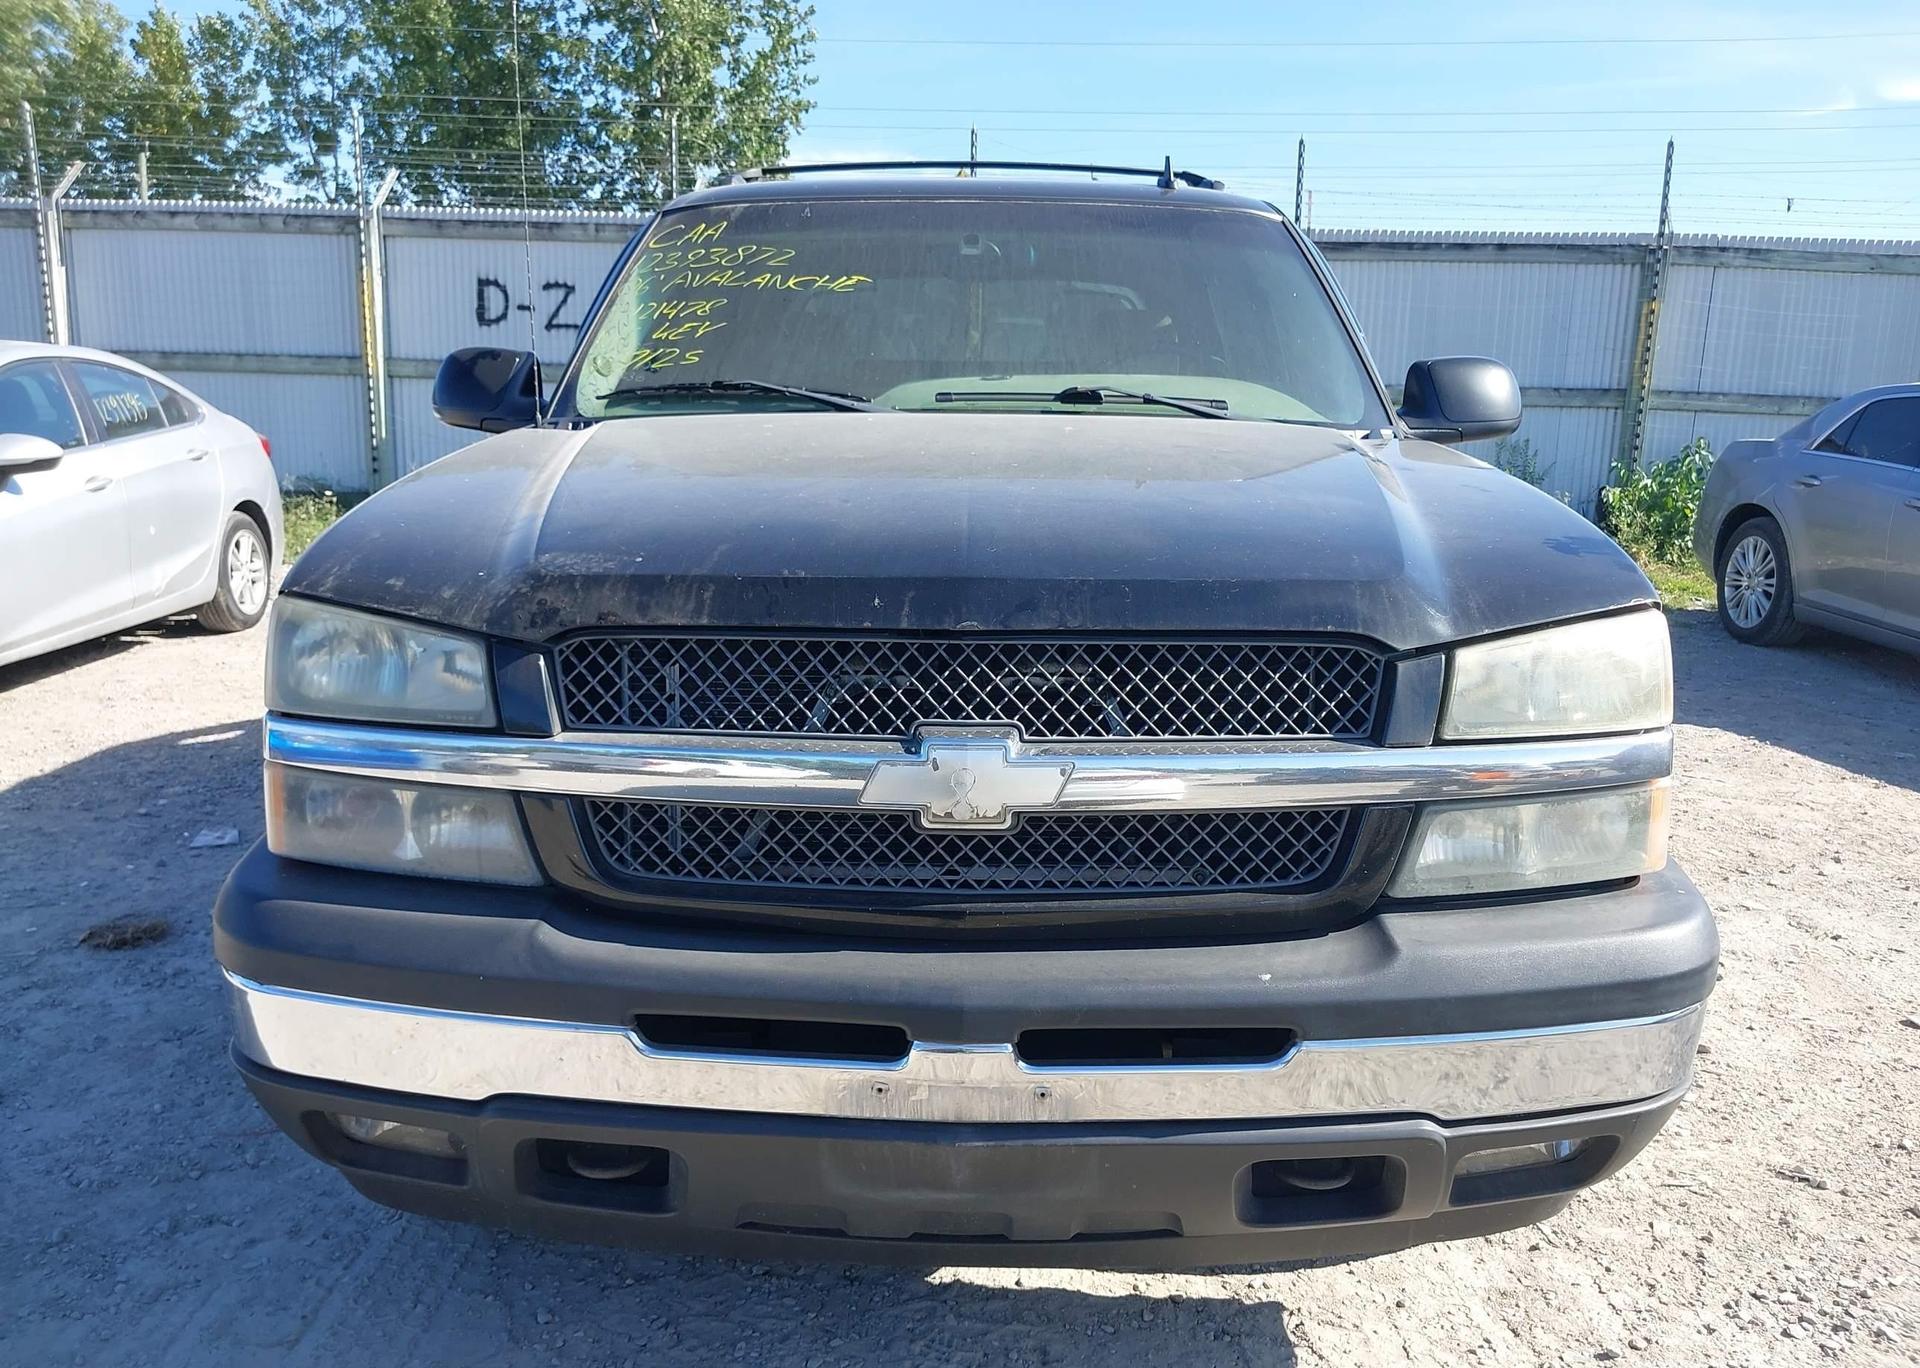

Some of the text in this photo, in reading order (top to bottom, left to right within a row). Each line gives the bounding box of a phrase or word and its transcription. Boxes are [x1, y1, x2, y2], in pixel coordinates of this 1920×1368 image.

[649, 221, 728, 248] CAA
[631, 245, 797, 274] 12393872
[661, 270, 873, 293] AVALANCHE
